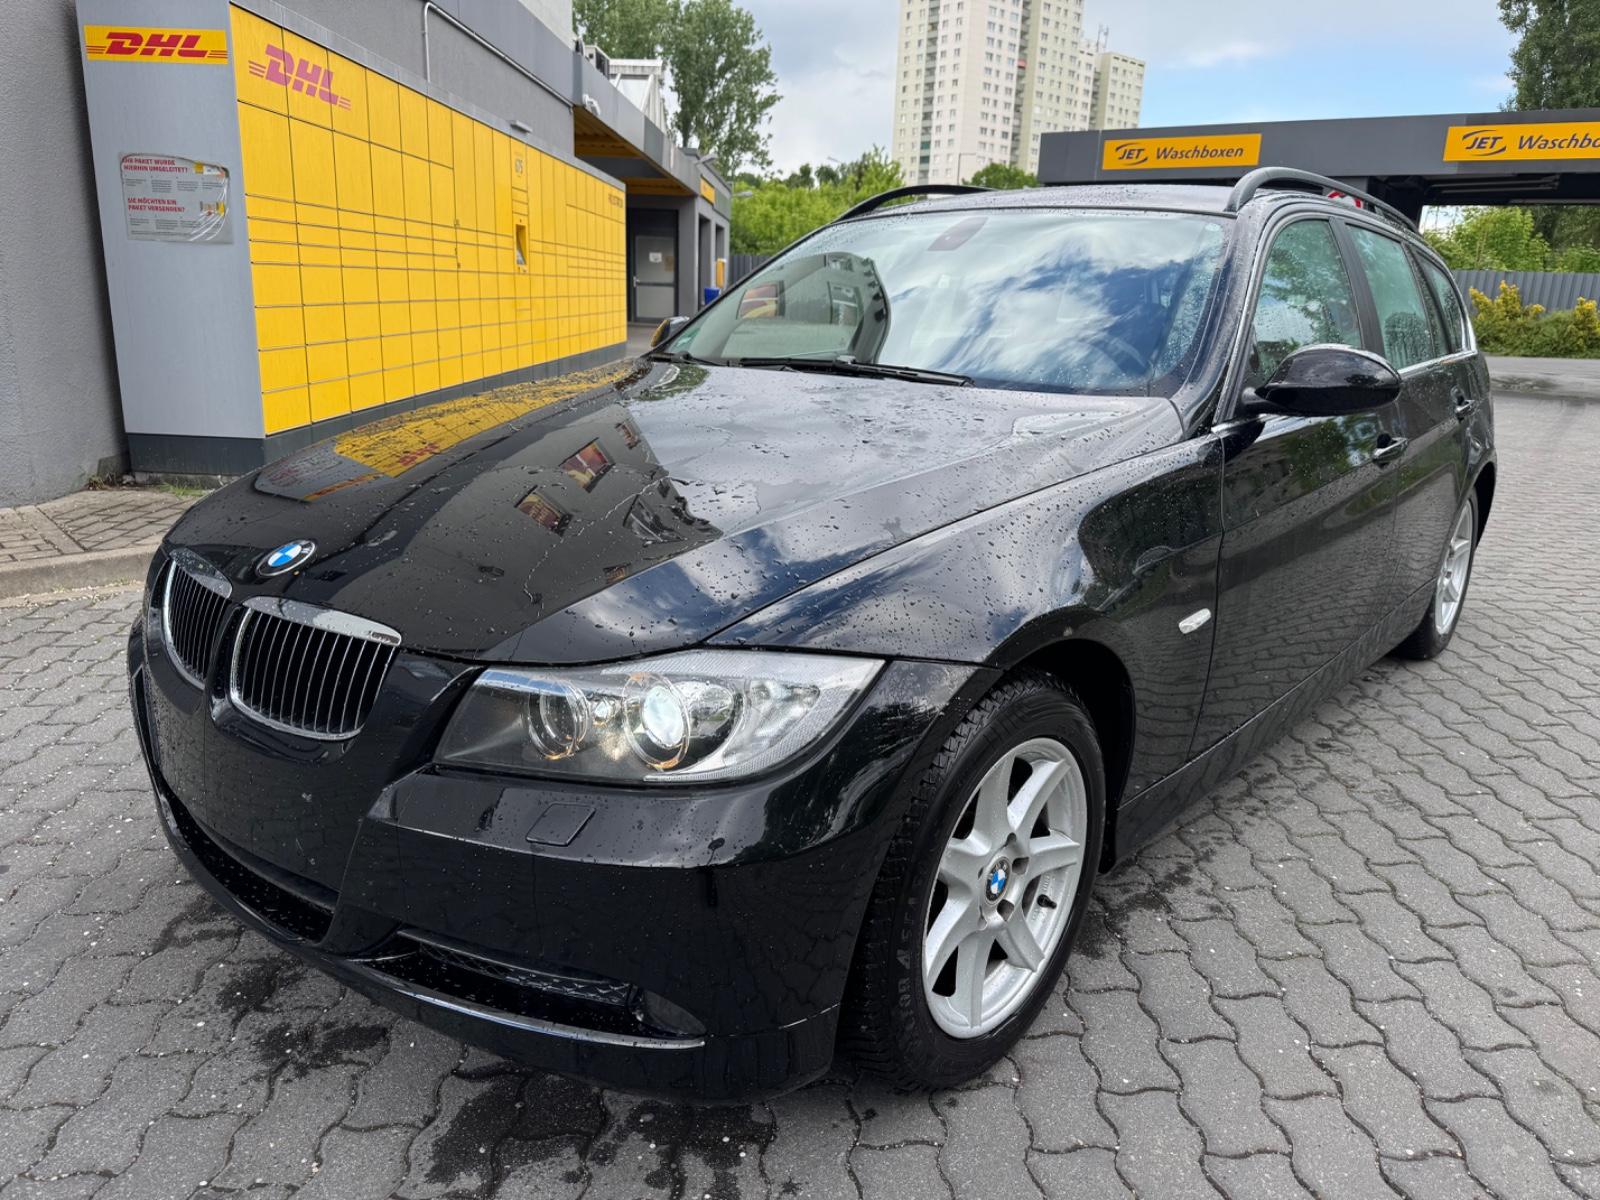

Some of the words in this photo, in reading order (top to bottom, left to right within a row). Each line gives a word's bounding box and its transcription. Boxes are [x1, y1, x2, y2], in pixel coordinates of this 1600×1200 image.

[105, 31, 209, 58] DHL
[265, 44, 339, 105] DHL
[1116, 147, 1146, 161] JET
[1156, 145, 1244, 160] Waschboxen
[1464, 135, 1504, 151] JET
